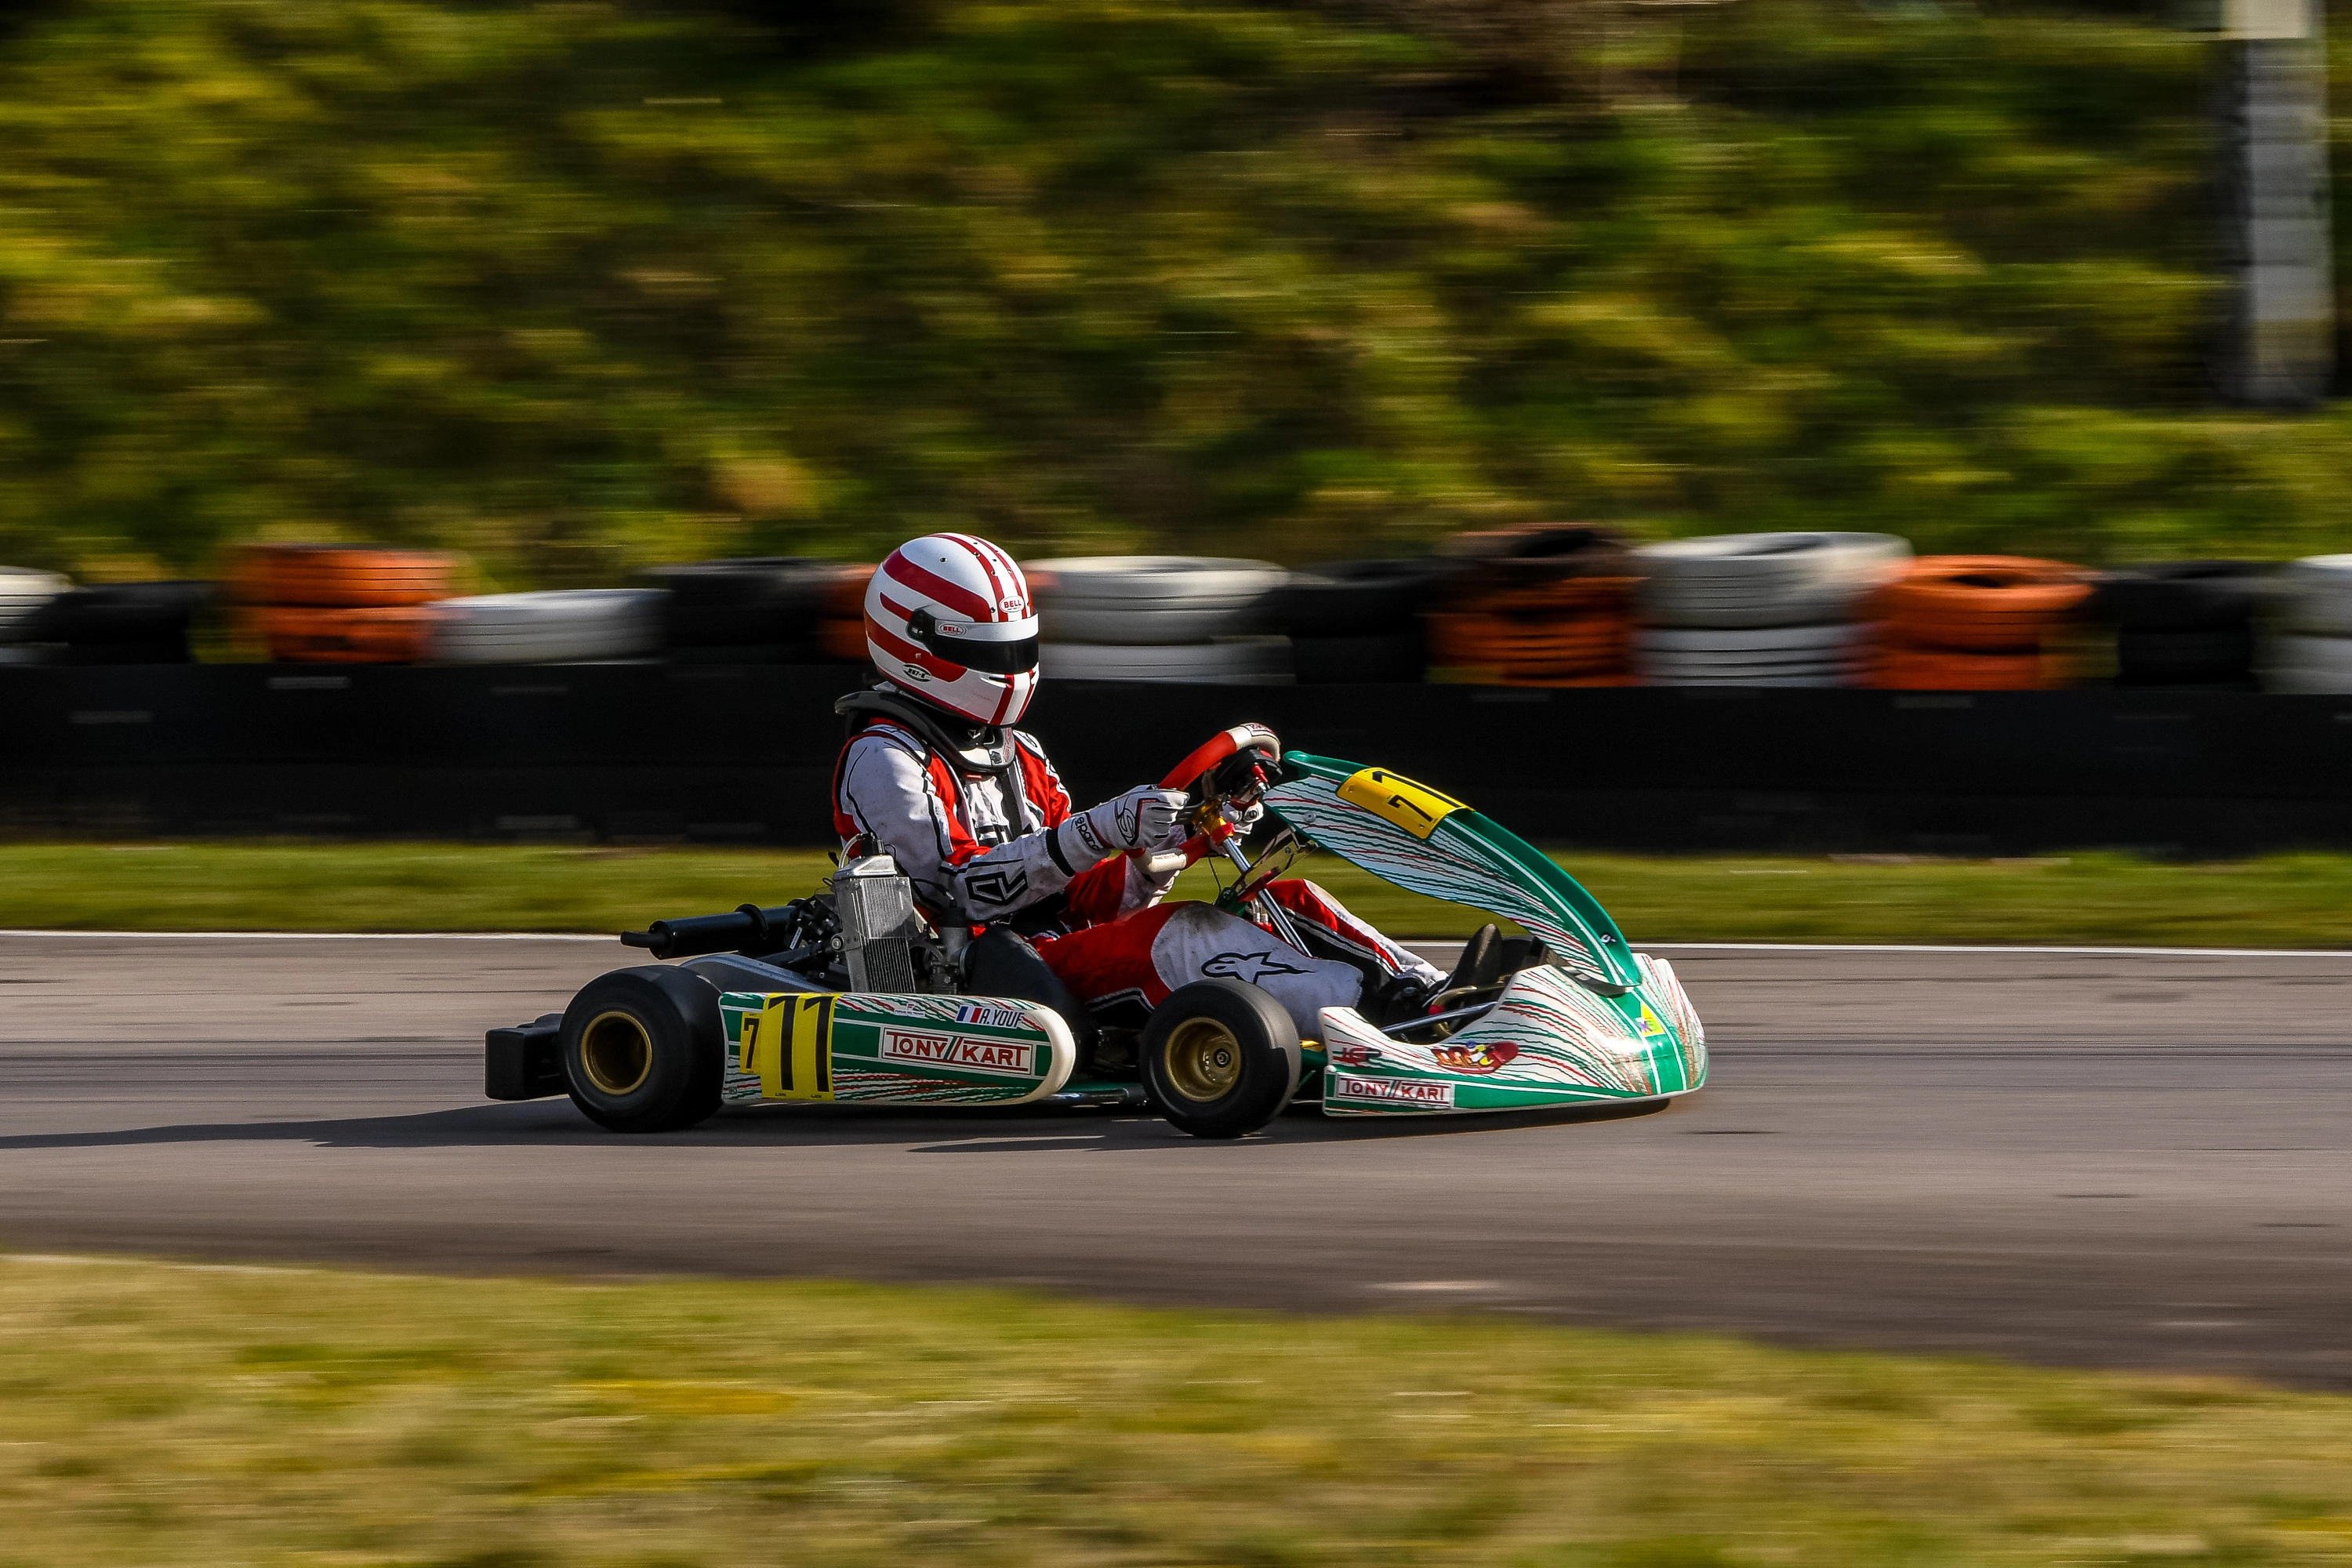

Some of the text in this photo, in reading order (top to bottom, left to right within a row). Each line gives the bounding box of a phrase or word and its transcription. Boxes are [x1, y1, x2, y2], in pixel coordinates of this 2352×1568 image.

[1004, 600, 1022, 608] BELL
[1388, 794, 1434, 822] 7
[743, 1018, 760, 1069] 7
[768, 995, 835, 1093] 11
